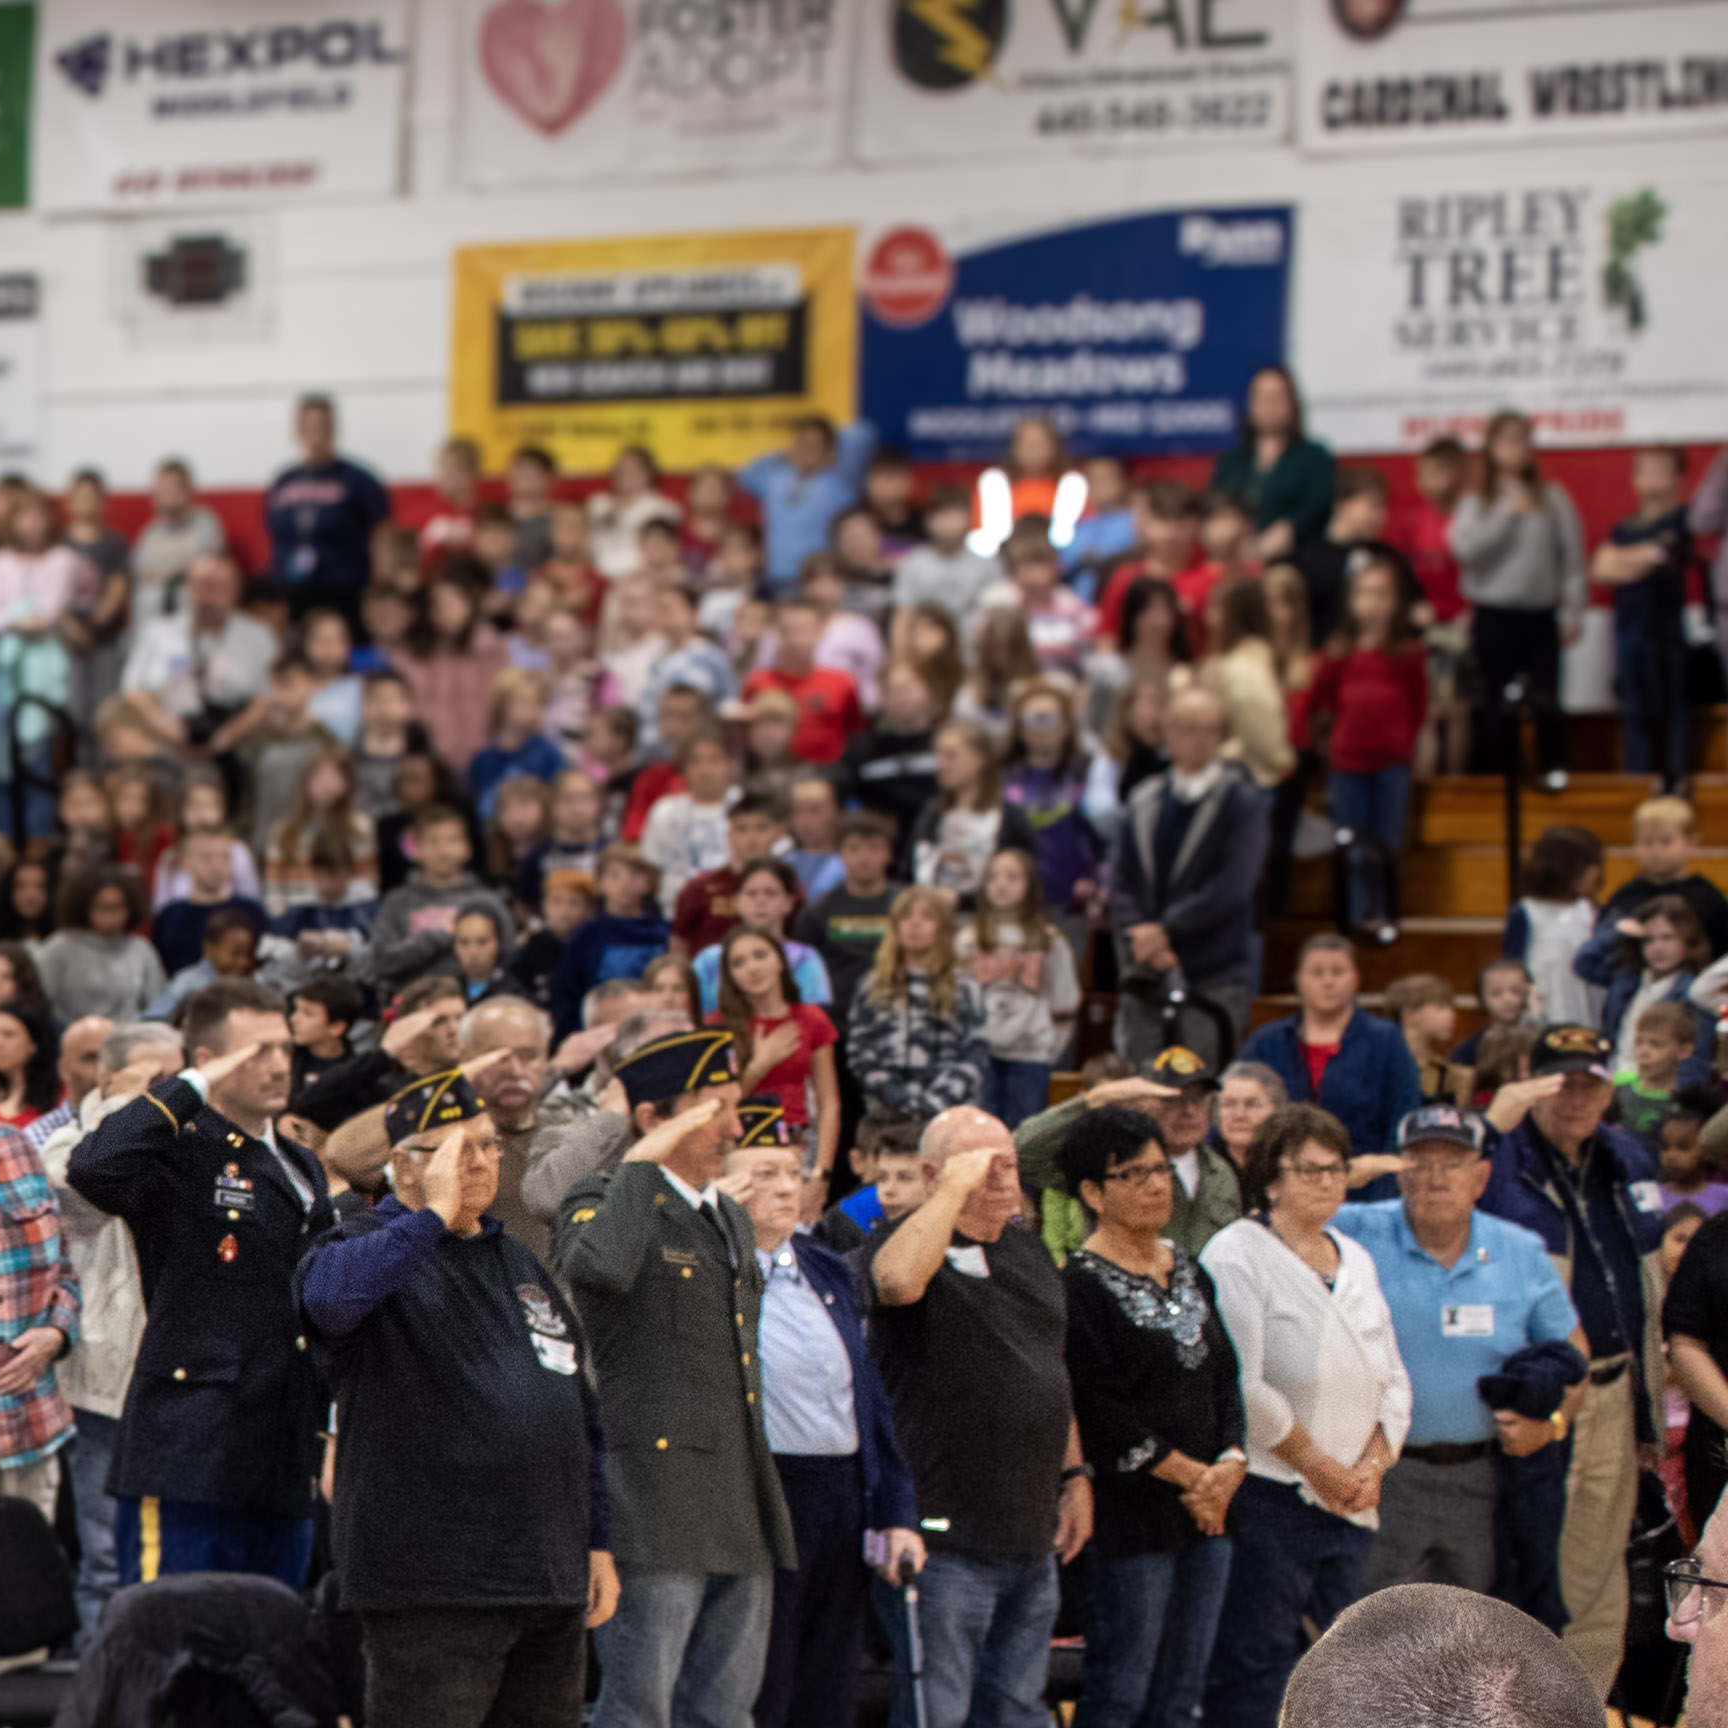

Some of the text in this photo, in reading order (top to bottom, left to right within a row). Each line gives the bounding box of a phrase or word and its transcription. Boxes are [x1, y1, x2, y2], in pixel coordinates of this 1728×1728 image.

[126, 20, 410, 80] HEXPOL
[634, 37, 832, 97] ADOPT
[1322, 69, 1509, 131] CARDINAL
[1397, 189, 1591, 241] RIPLEY
[1399, 245, 1587, 308] TREE
[956, 295, 1201, 349] Woodsong
[1394, 316, 1581, 355] SERVICE
[970, 352, 1182, 395] Meadows
